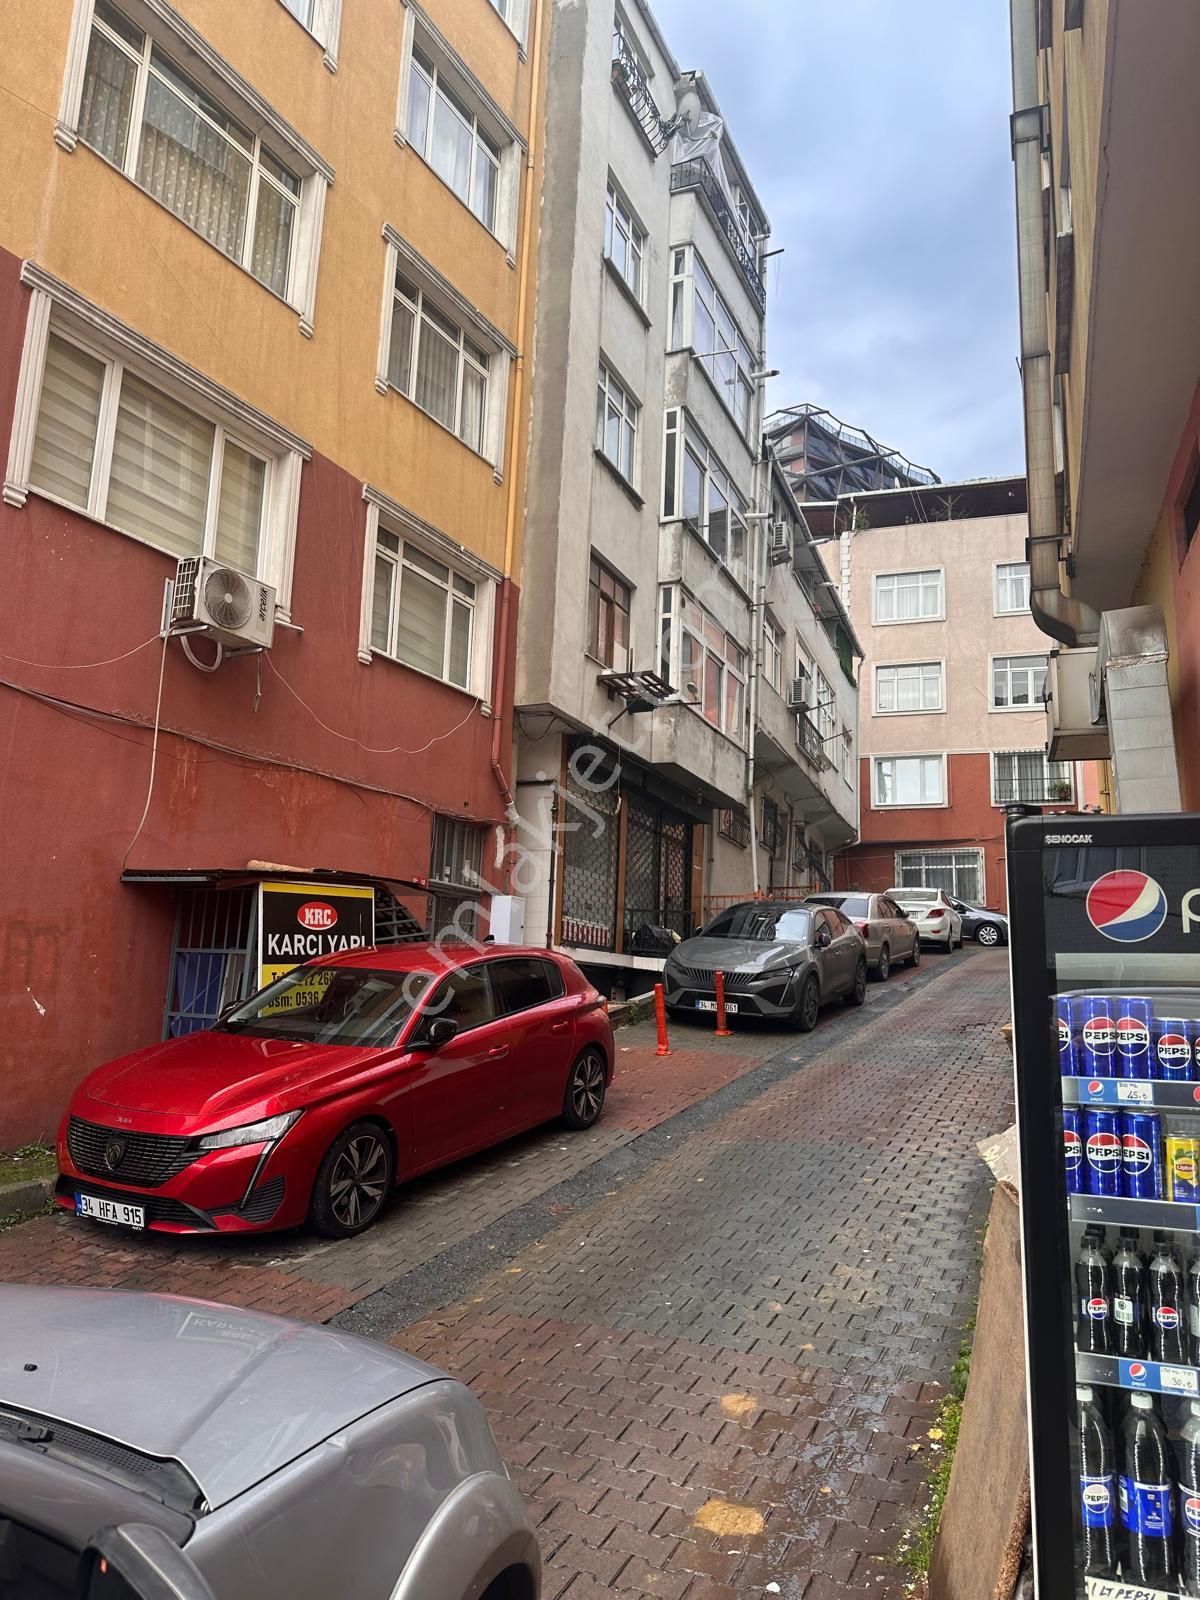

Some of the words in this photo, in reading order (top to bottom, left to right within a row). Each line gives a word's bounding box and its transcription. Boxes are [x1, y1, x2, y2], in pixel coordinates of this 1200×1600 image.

[304, 908, 332, 925] KRC
[268, 933, 323, 956] KARCI
[1158, 1047, 1190, 1056] PEPSI
[82, 1197, 94, 1214] 34
[98, 1201, 118, 1220] HFA
[122, 1206, 142, 1225] 915
[1099, 1585, 1113, 1597] LT
